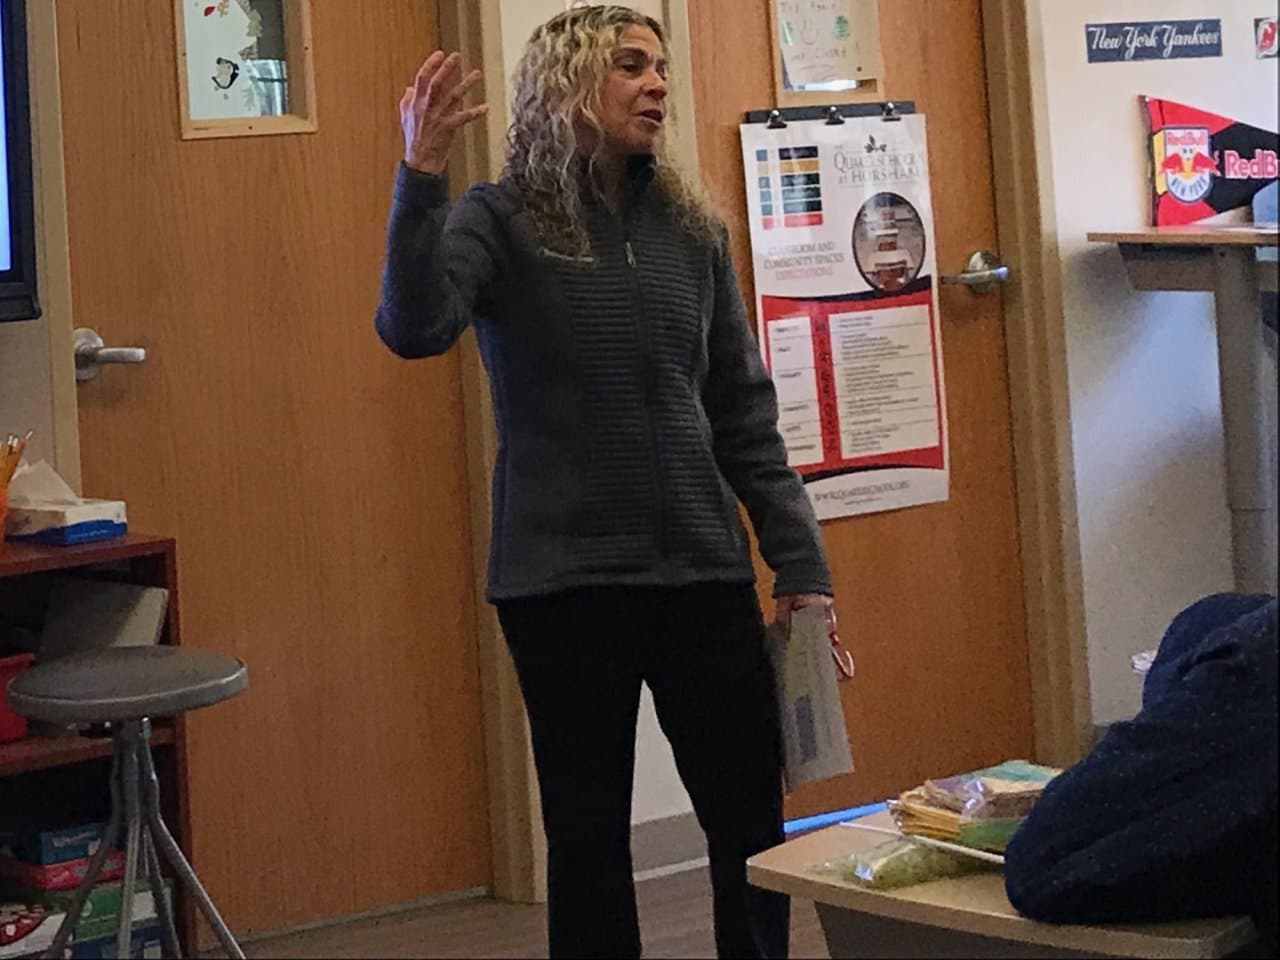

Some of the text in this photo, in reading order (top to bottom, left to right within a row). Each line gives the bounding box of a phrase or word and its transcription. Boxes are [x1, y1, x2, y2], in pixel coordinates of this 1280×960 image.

[1088, 23, 1220, 60] New York Yankees
